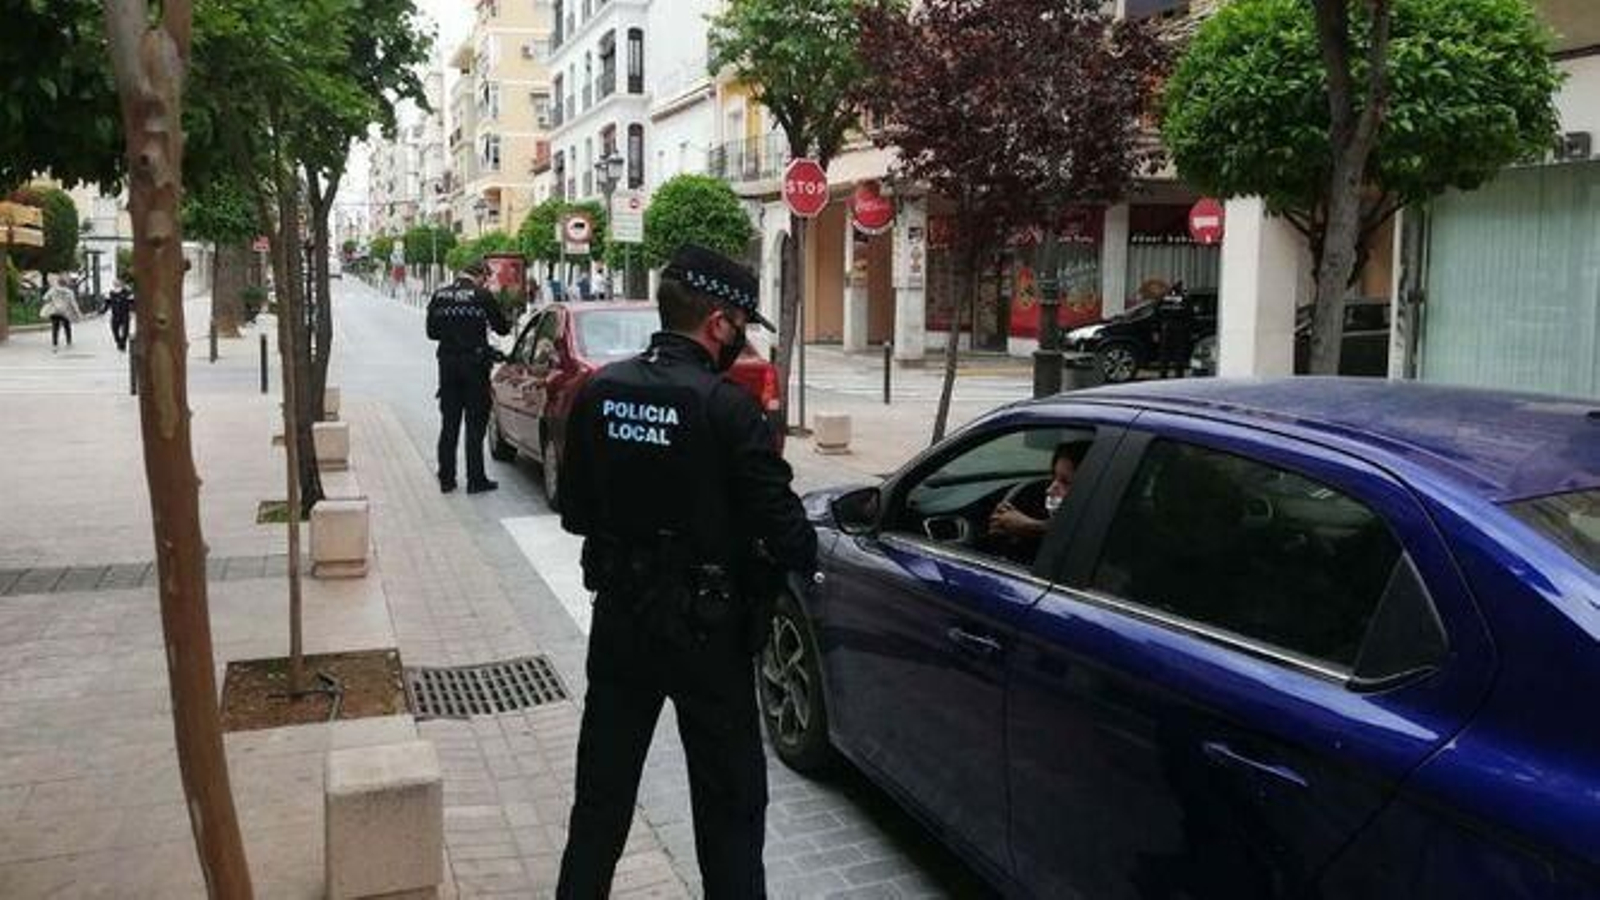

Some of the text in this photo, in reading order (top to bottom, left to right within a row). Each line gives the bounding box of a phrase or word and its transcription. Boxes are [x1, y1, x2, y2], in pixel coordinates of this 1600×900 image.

[785, 180, 826, 195] STOP
[602, 399, 679, 425] POLICIA
[607, 422, 671, 446] LOCAL
